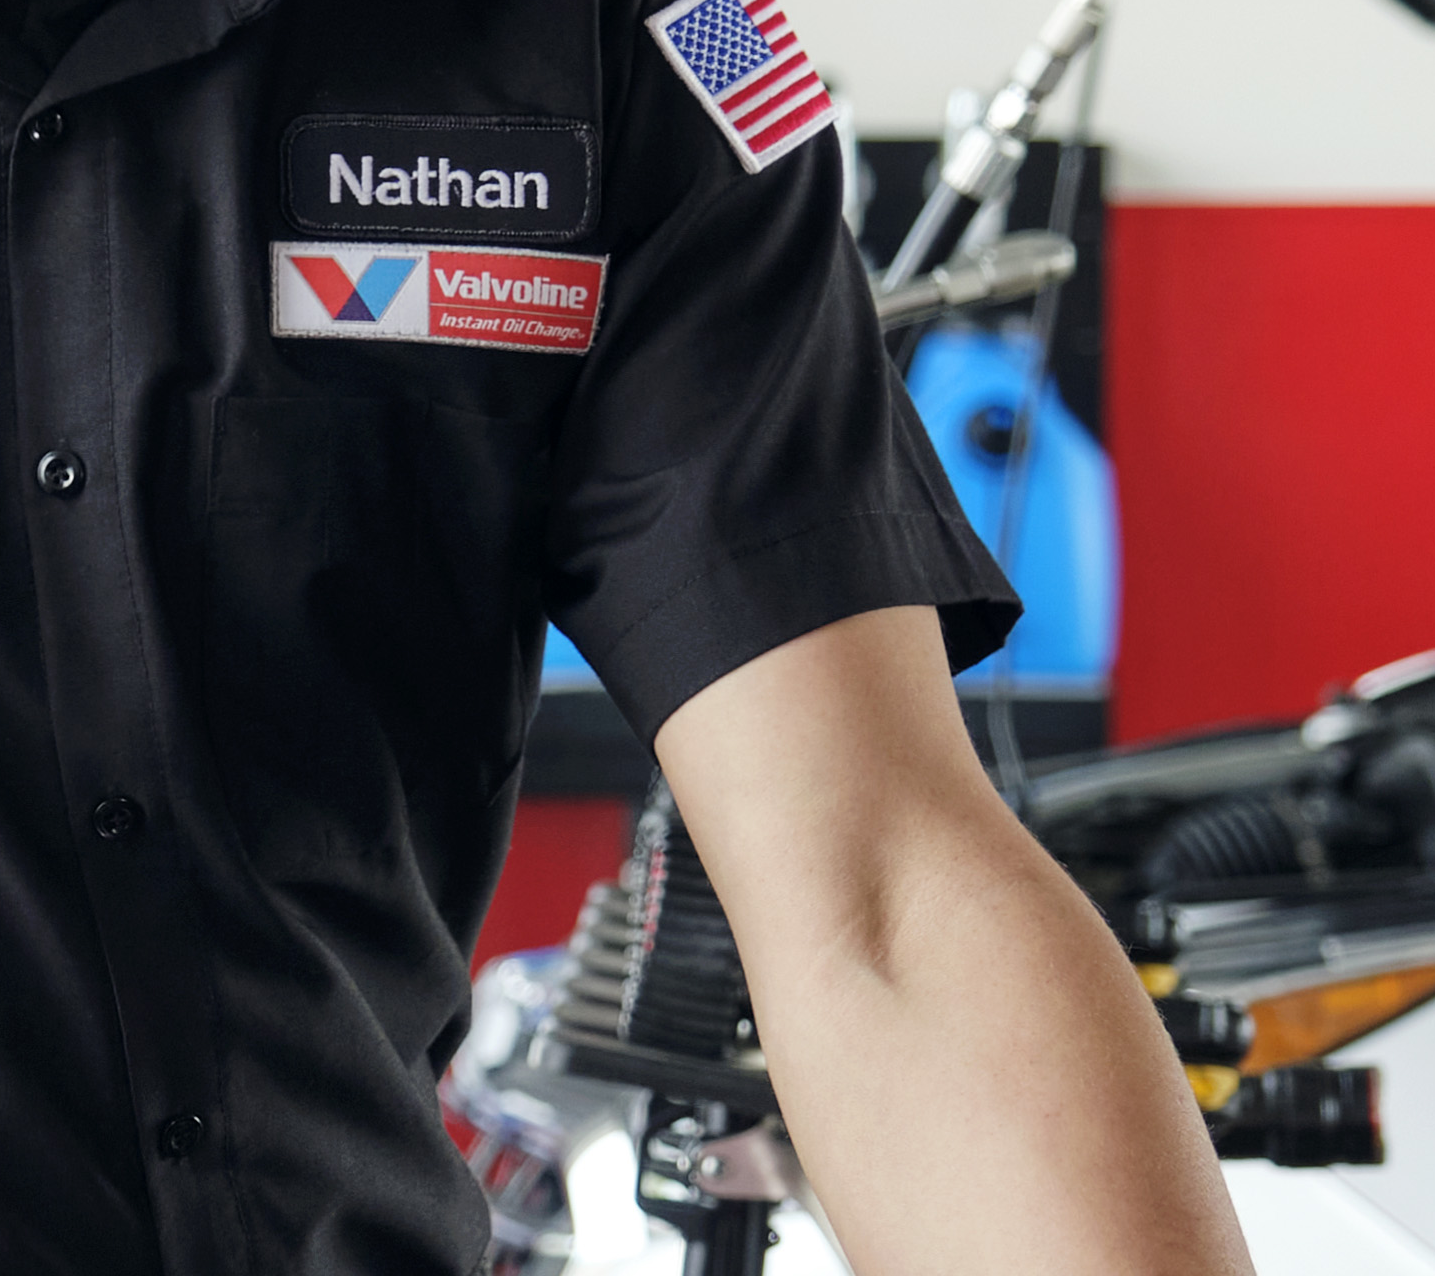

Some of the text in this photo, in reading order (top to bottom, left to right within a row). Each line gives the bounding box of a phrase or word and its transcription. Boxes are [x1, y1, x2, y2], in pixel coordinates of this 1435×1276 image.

[329, 153, 549, 210] Nathan
[434, 268, 588, 310] Valvoline
[439, 312, 581, 342] Instant Oil Change
